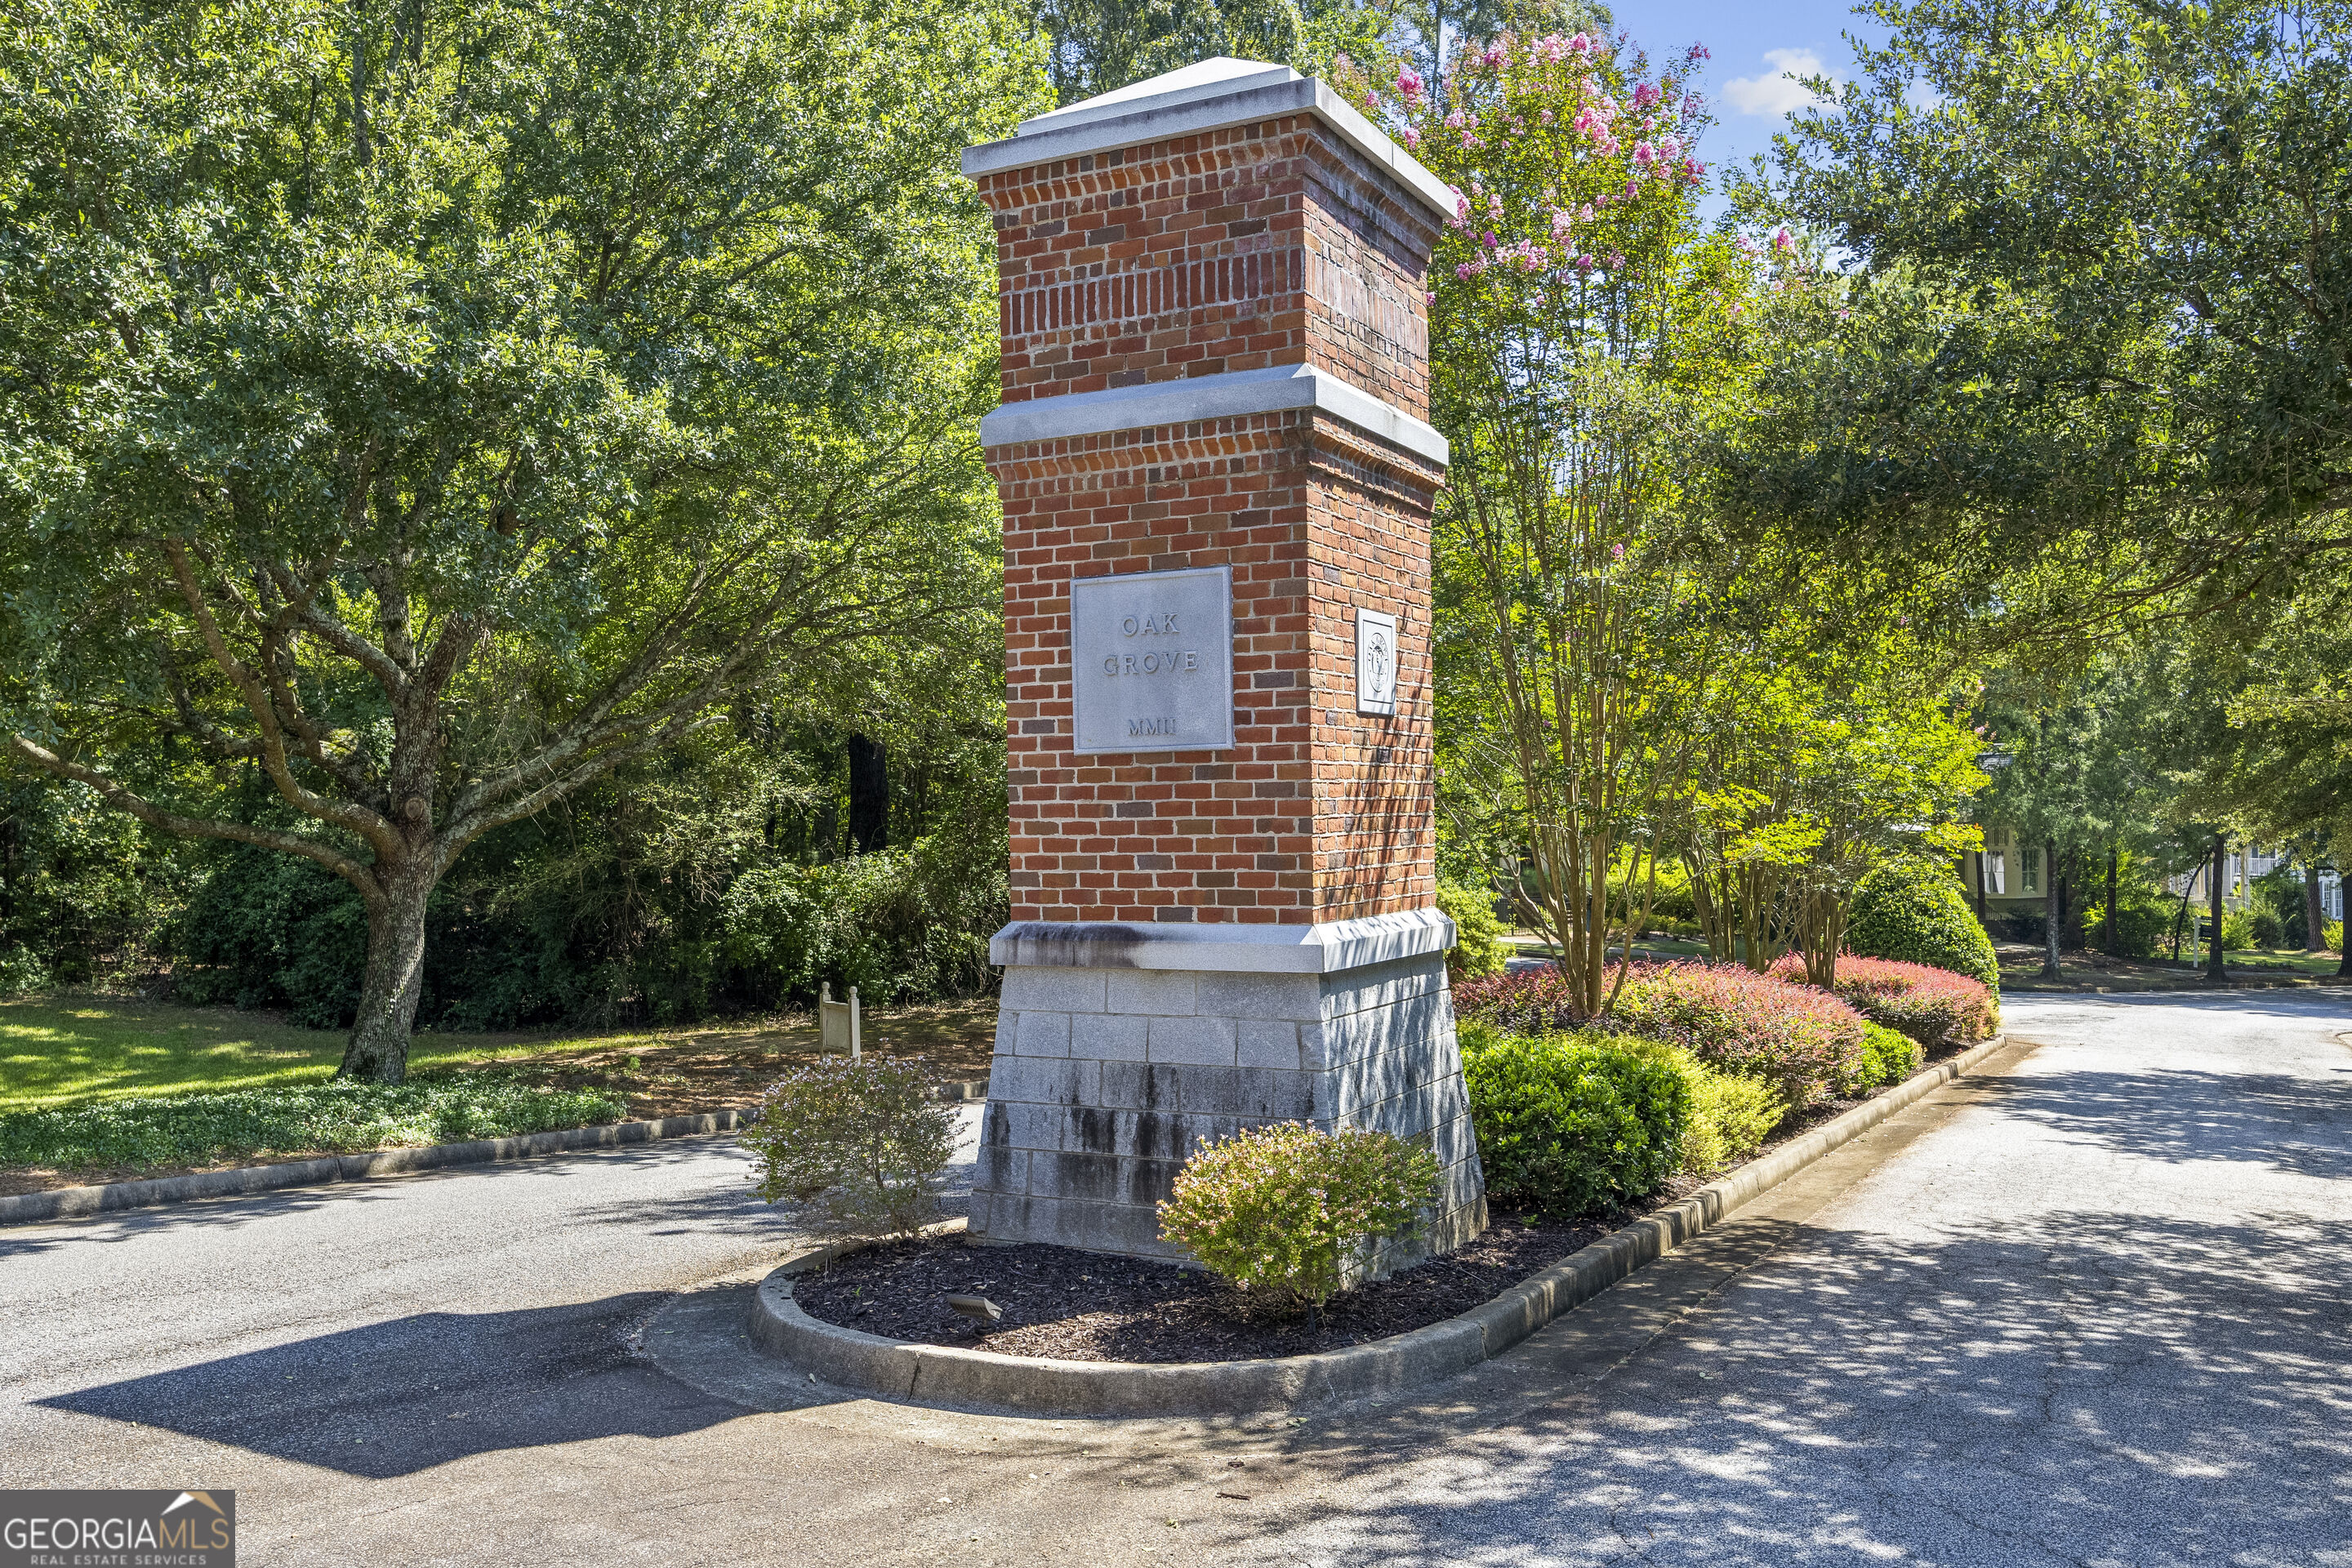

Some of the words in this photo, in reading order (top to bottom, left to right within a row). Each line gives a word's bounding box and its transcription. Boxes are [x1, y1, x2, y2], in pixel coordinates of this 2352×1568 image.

[1122, 612, 1181, 637] OAK
[1103, 650, 1198, 677] GROVE
[1128, 717, 1176, 736] MMII
